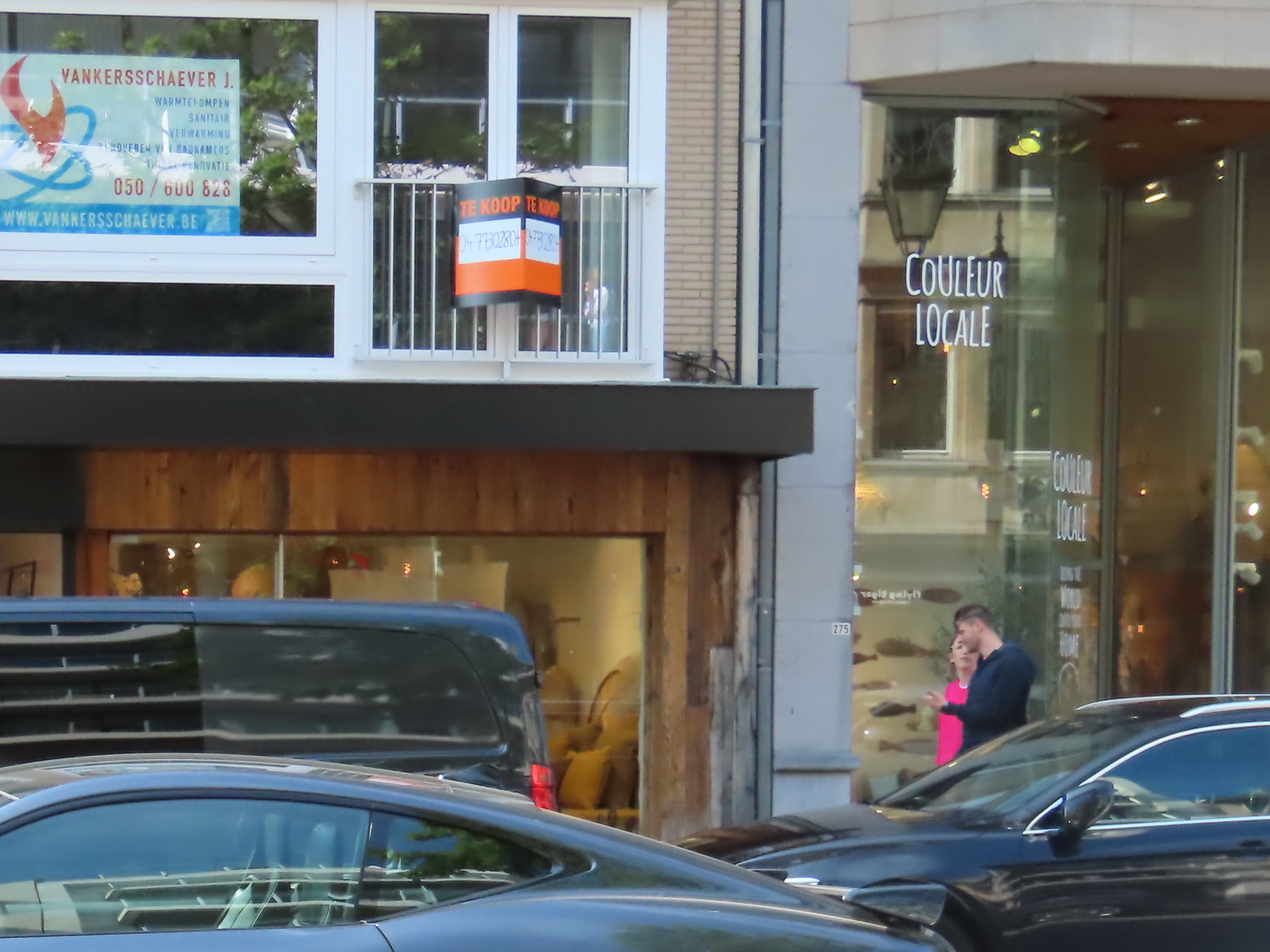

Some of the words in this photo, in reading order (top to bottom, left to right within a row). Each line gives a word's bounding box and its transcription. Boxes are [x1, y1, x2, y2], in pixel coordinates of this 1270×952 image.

[61, 67, 216, 87] VANKERSSCHAEVER
[224, 71, 234, 88] J.
[155, 97, 230, 108] WARMTEPOMPEN
[189, 113, 230, 123] SANITAIR
[170, 129, 230, 139] VERWARMING
[114, 177, 144, 196] 050
[150, 178, 158, 198] /
[164, 179, 194, 197] 600
[202, 179, 231, 197] 828
[459, 200, 476, 218] TE
[480, 195, 521, 215] KOOP
[525, 195, 537, 213] TE
[538, 198, 561, 218] KOOP
[4, 211, 198, 230] WWW.VANKERSSCHAEVER.BE
[905, 252, 1004, 299] COULEUR
[915, 302, 991, 348] LOCALE
[1057, 499, 1087, 542] LOCALE
[833, 624, 849, 634] 275
